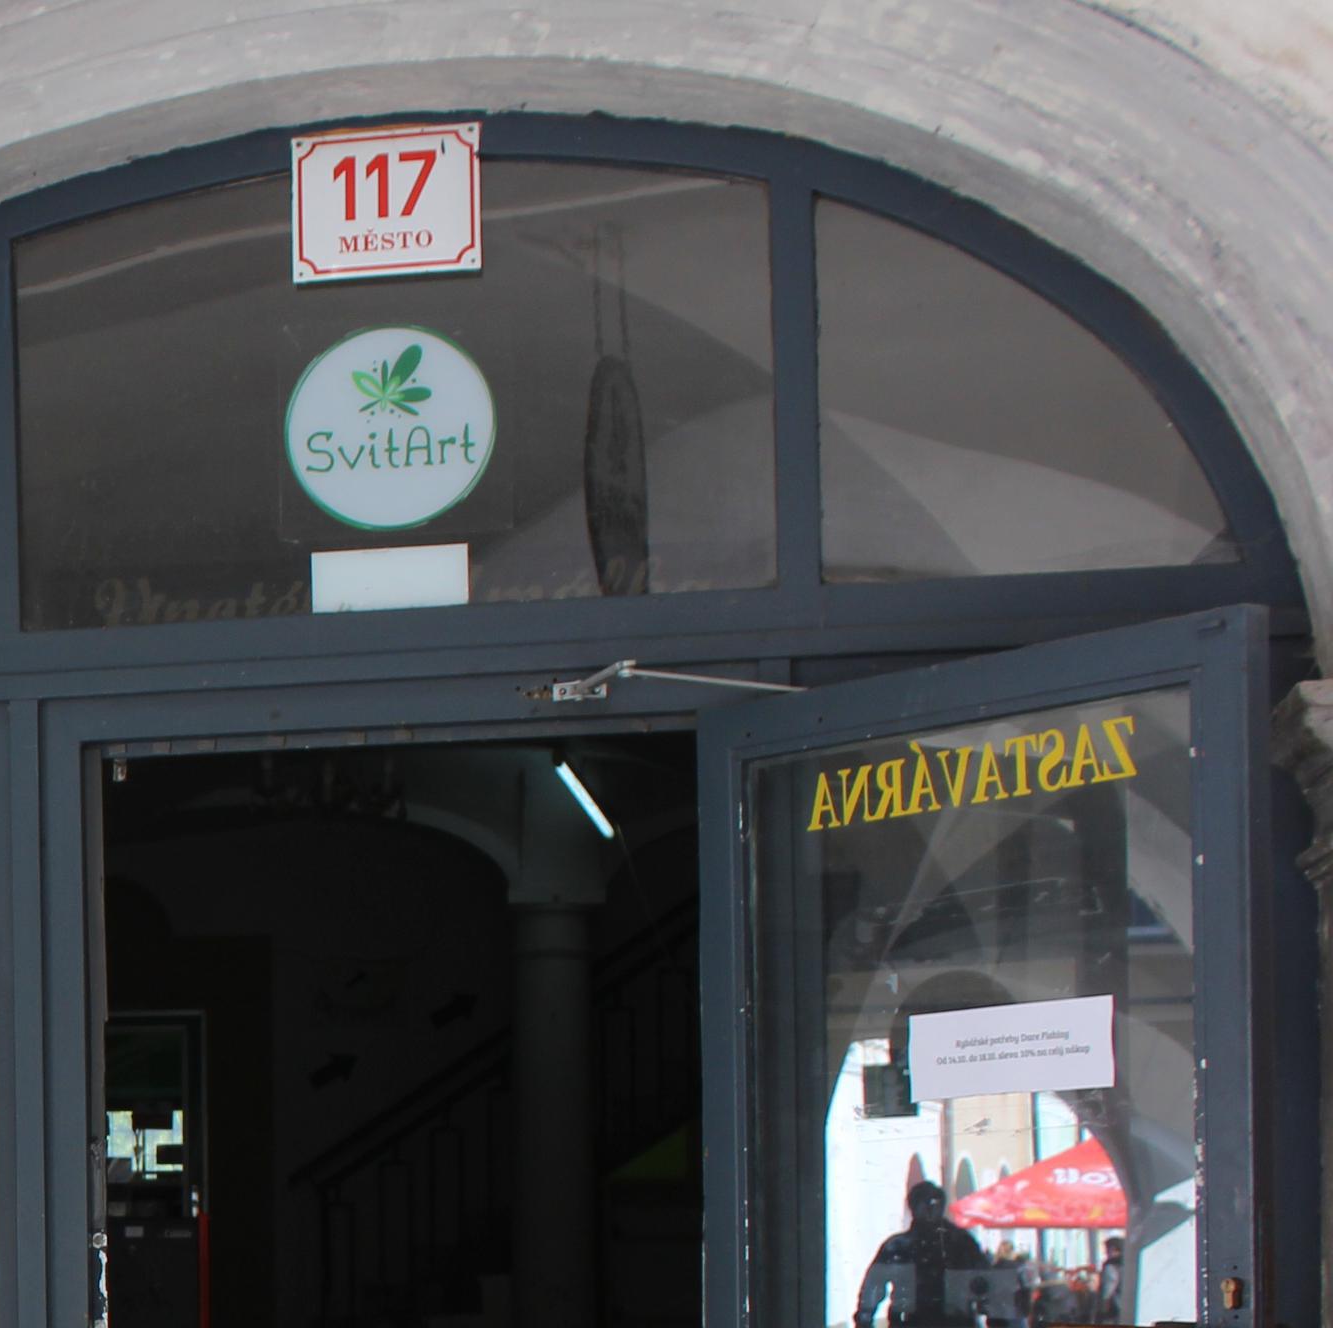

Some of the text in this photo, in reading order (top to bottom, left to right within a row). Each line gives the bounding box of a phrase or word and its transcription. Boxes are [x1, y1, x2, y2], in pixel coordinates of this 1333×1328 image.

[333, 149, 437, 221] 117
[338, 229, 433, 254] MĚSTO
[305, 422, 476, 474] SvitArt
